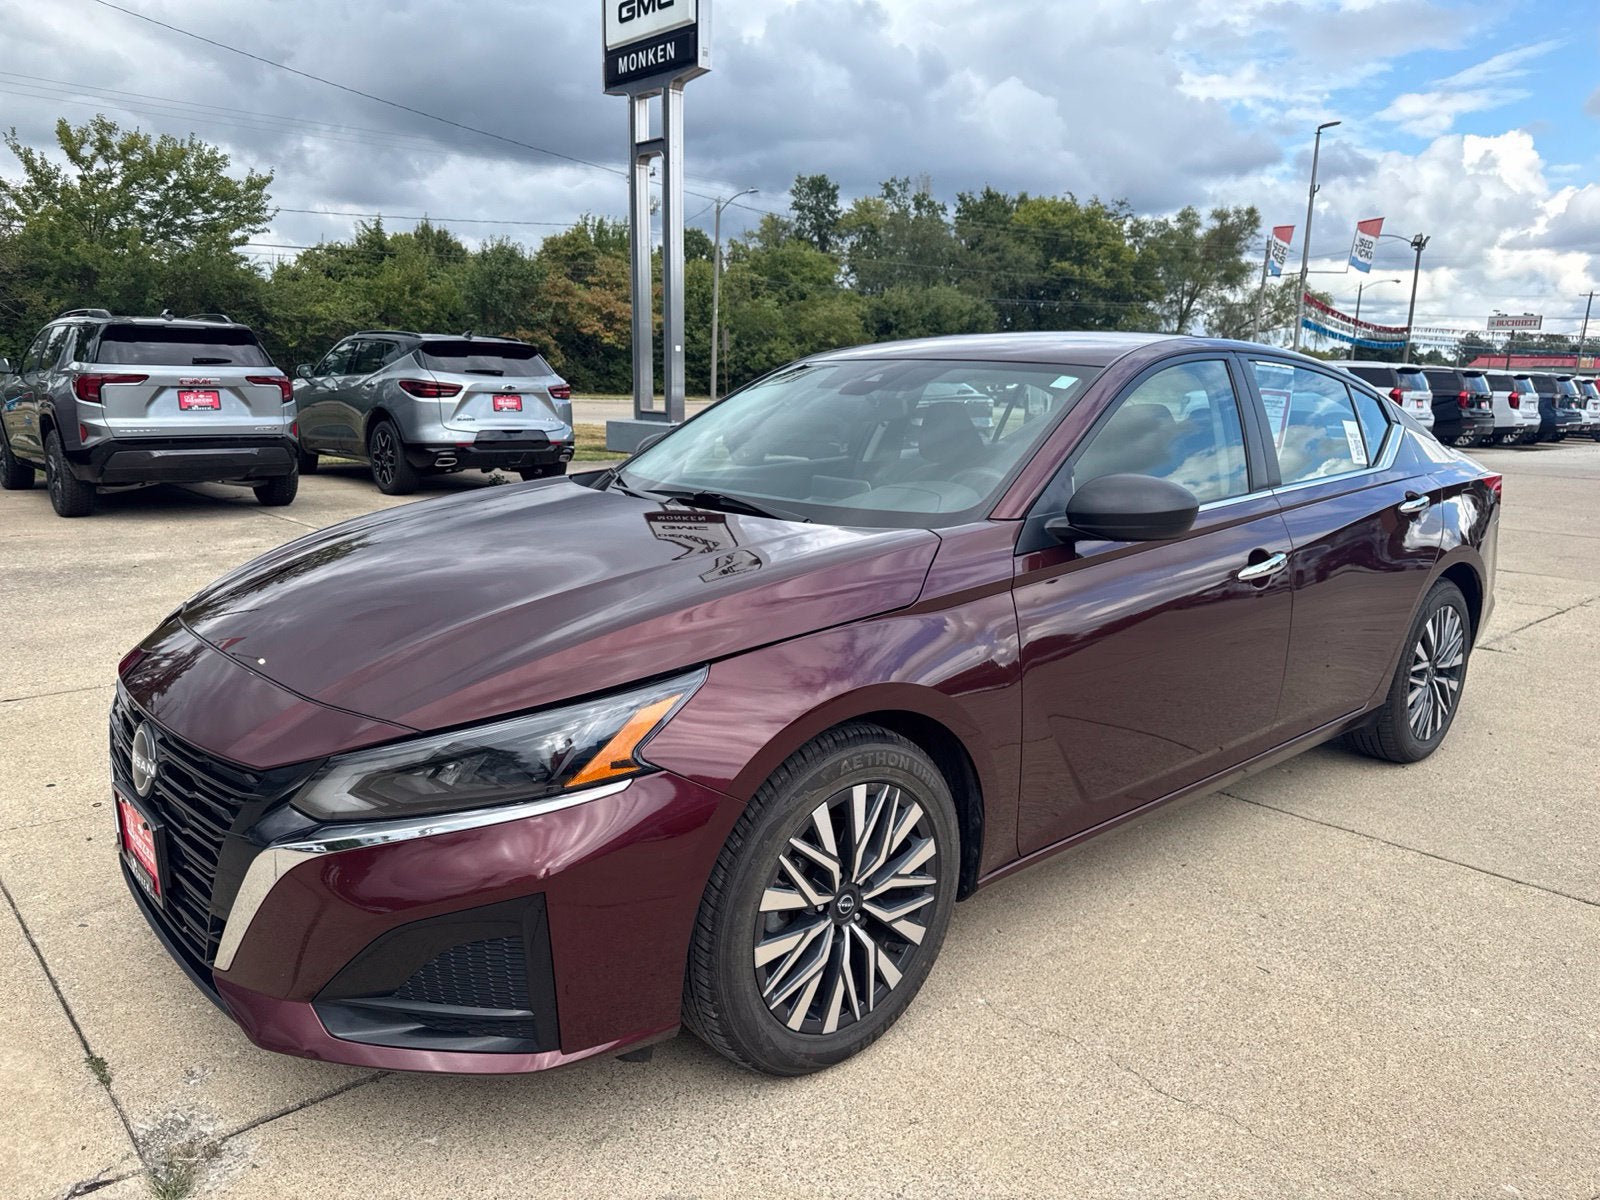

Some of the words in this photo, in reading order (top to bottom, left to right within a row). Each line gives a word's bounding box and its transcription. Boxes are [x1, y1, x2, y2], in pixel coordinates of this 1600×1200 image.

[618, 41, 676, 75] MONKEN
[1358, 237, 1374, 251] SED
[1496, 319, 1538, 327] BUCHHEIT
[839, 751, 910, 775] AETHON
